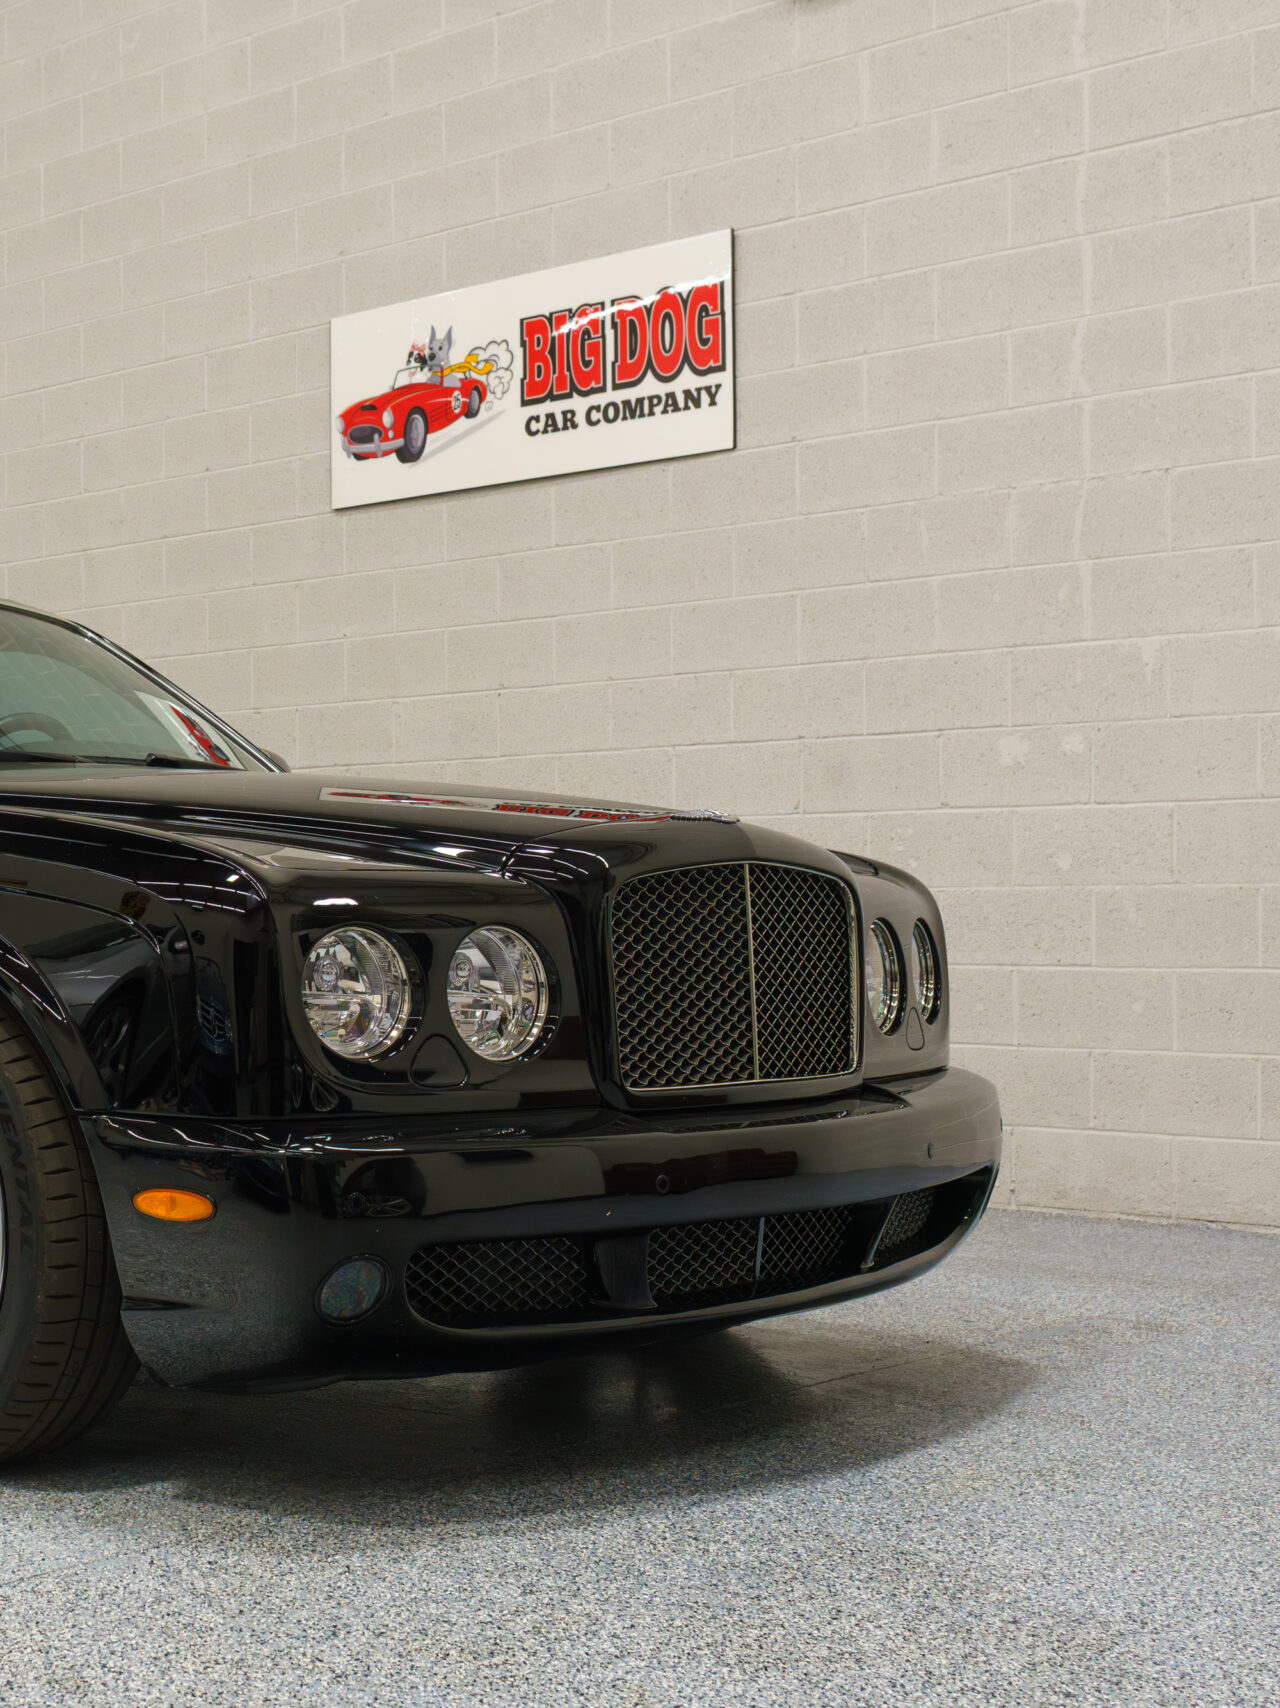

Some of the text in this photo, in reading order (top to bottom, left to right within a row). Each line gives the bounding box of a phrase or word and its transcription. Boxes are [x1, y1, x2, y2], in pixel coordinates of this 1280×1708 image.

[520, 279, 725, 407] BIG DOG
[524, 384, 722, 436] CAR COMPANY
